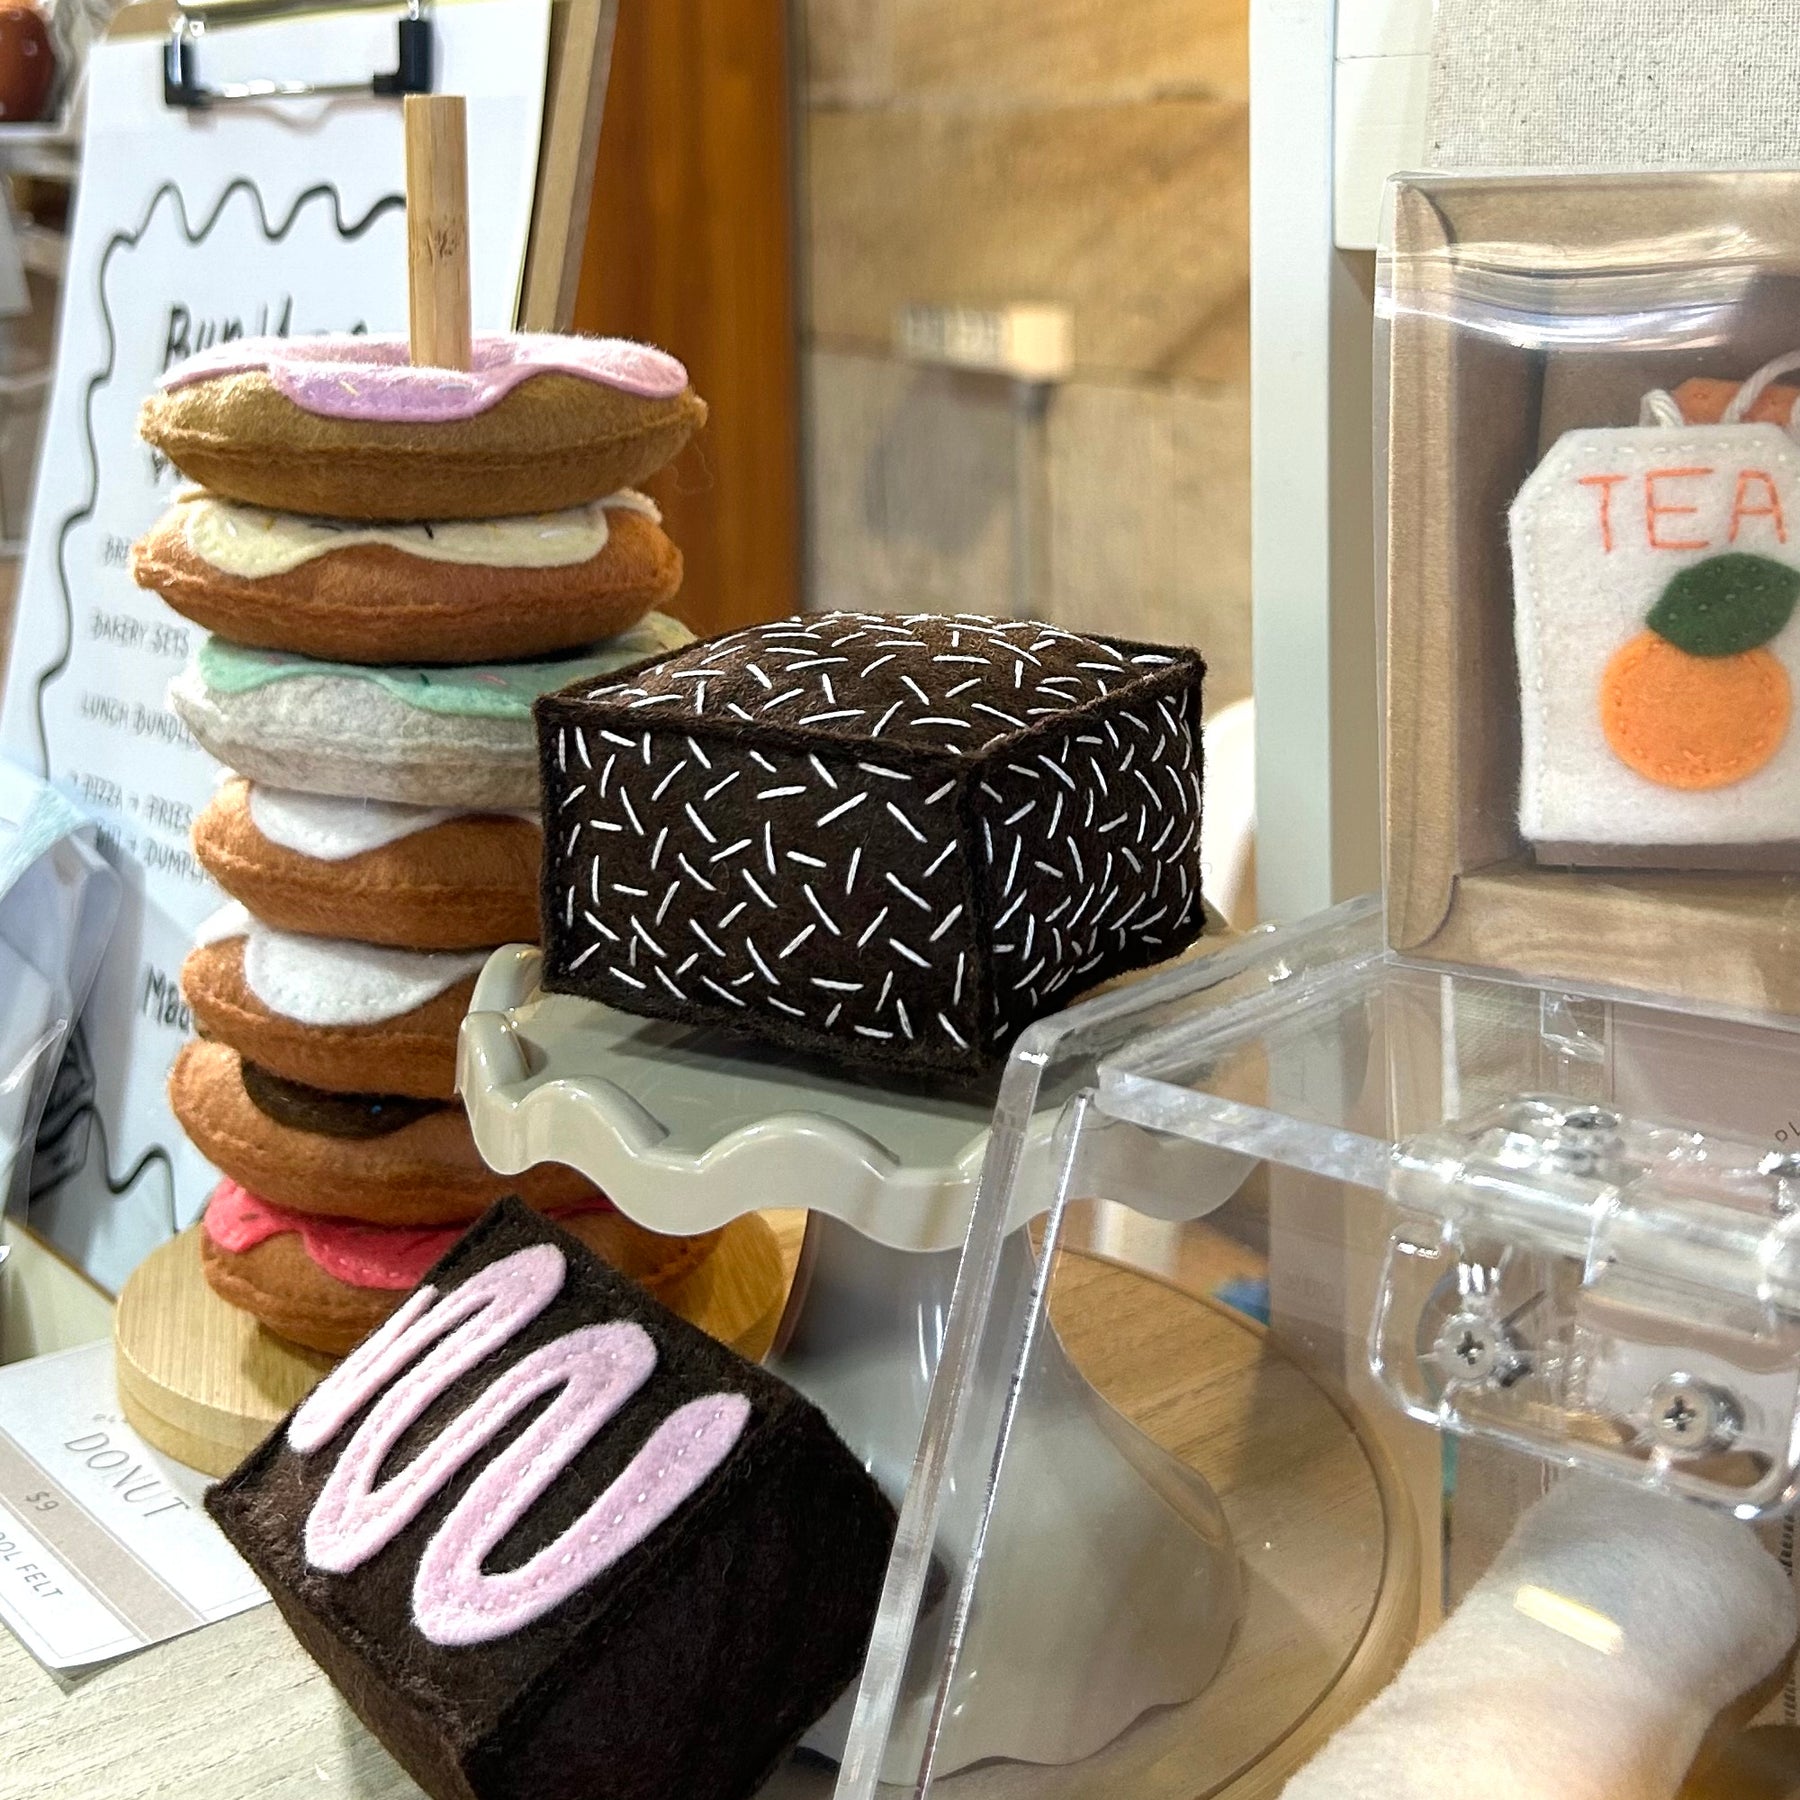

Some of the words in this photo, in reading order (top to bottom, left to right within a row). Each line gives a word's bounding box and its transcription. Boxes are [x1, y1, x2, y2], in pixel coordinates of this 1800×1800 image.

[1577, 467, 1788, 554] TEA
[92, 610, 145, 647] BAKERY
[152, 623, 190, 659] SETS
[81, 691, 129, 726] LUNCH
[82, 773, 123, 811] PIZZA
[145, 796, 194, 835] FRIES
[64, 1432, 190, 1517] DONUT
[16, 1563, 63, 1597] FELT
